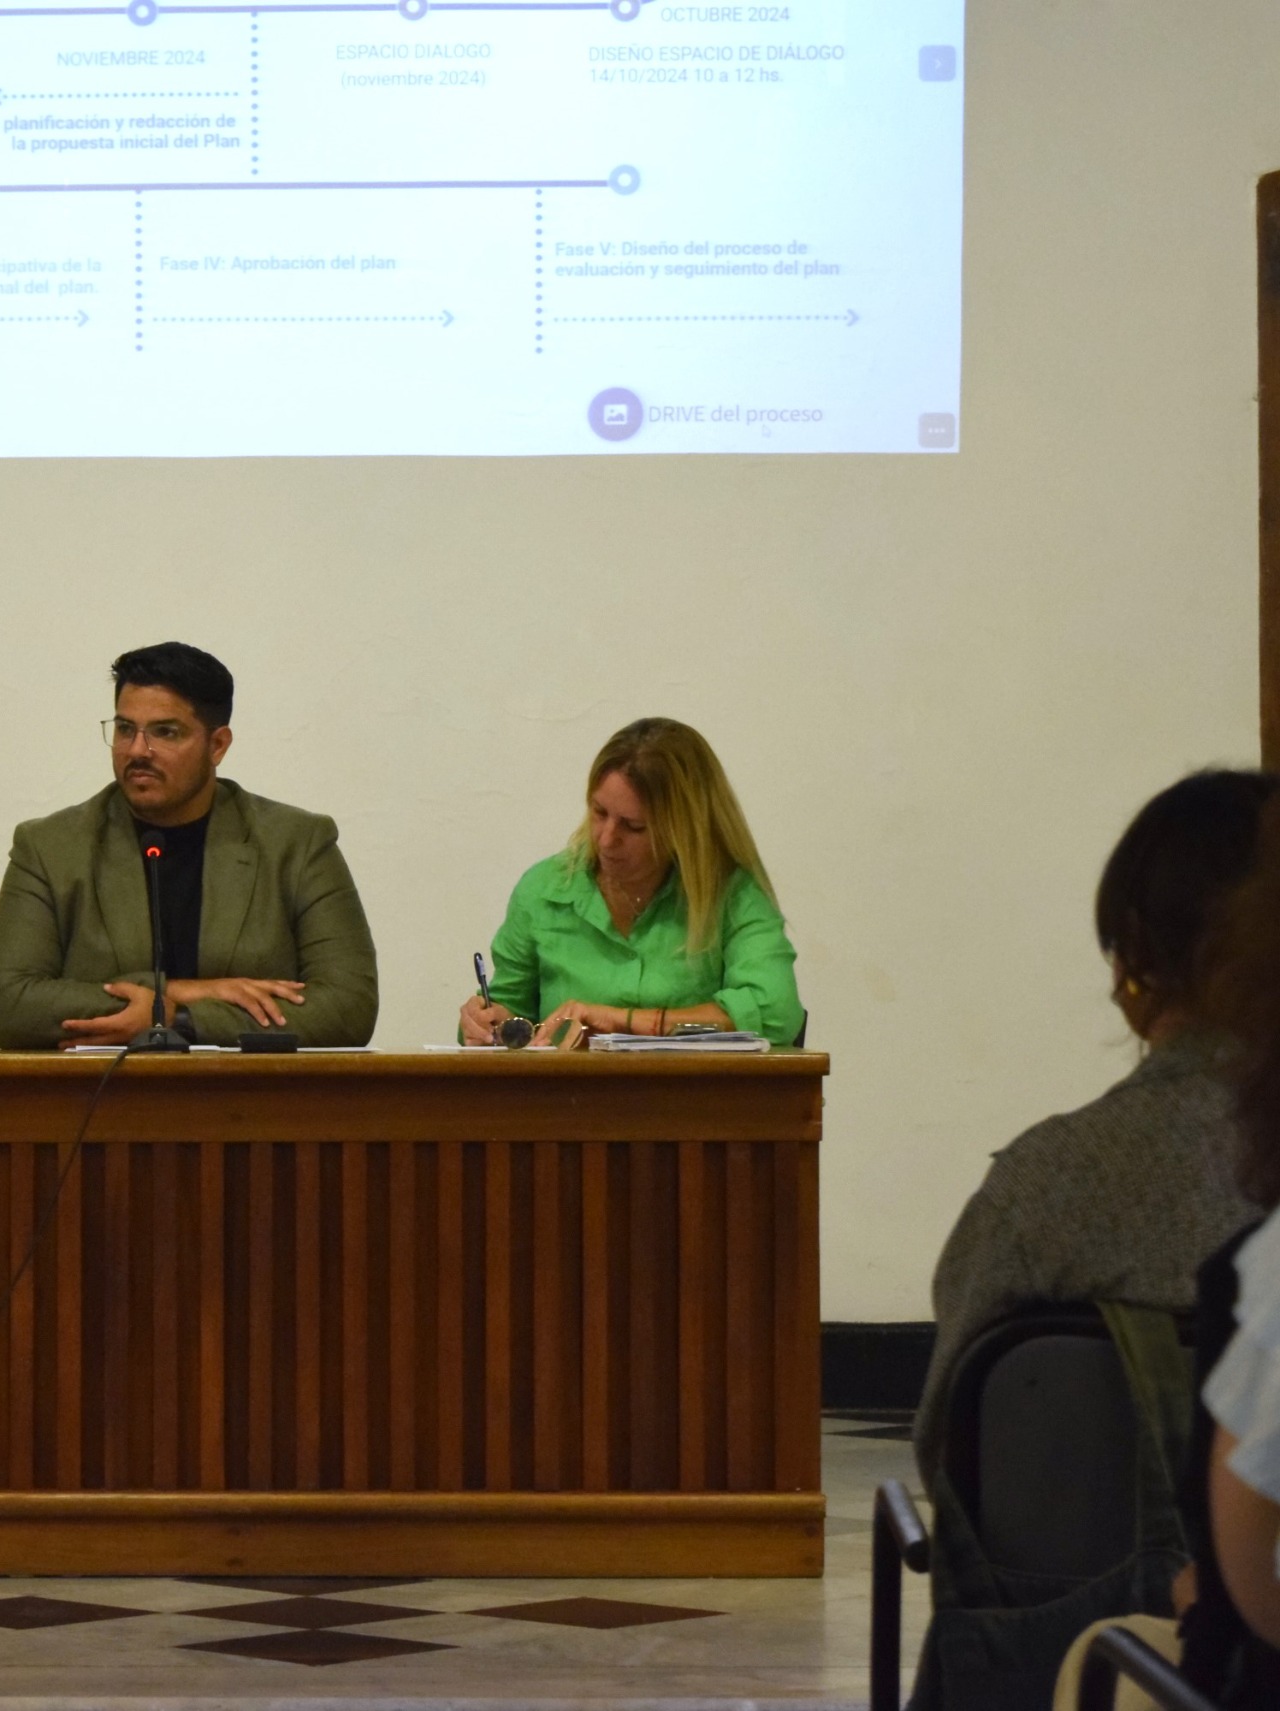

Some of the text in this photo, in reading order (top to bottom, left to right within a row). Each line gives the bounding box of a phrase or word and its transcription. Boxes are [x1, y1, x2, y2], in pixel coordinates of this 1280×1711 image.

[660, 6, 790, 22] OCTUBRE 2024
[56, 50, 206, 67] NOVIEMBRE 2024
[335, 44, 409, 60] ESPACIO
[588, 42, 845, 62] DISEÑO ESPACIO DE DIÁLOGO
[340, 69, 487, 90] (noviembre 2024)
[590, 67, 785, 84] 14/10/2024 10 a 12 hs.
[3, 115, 111, 134] planificación
[115, 118, 124, 132] y
[128, 114, 211, 129] redacción
[216, 114, 237, 127] de
[11, 133, 240, 153] la propuesta inicial del Plan
[555, 240, 808, 257] Fase V: Diseño del proceso de
[62, 258, 82, 273] de
[87, 257, 101, 273] la
[160, 254, 396, 273] Fase IV: Aprobación del plan
[555, 260, 840, 279] evaluación y seguimiento del plan
[24, 280, 49, 295] del
[59, 279, 100, 298] plan.
[648, 405, 823, 425] DRIVE del proceso
